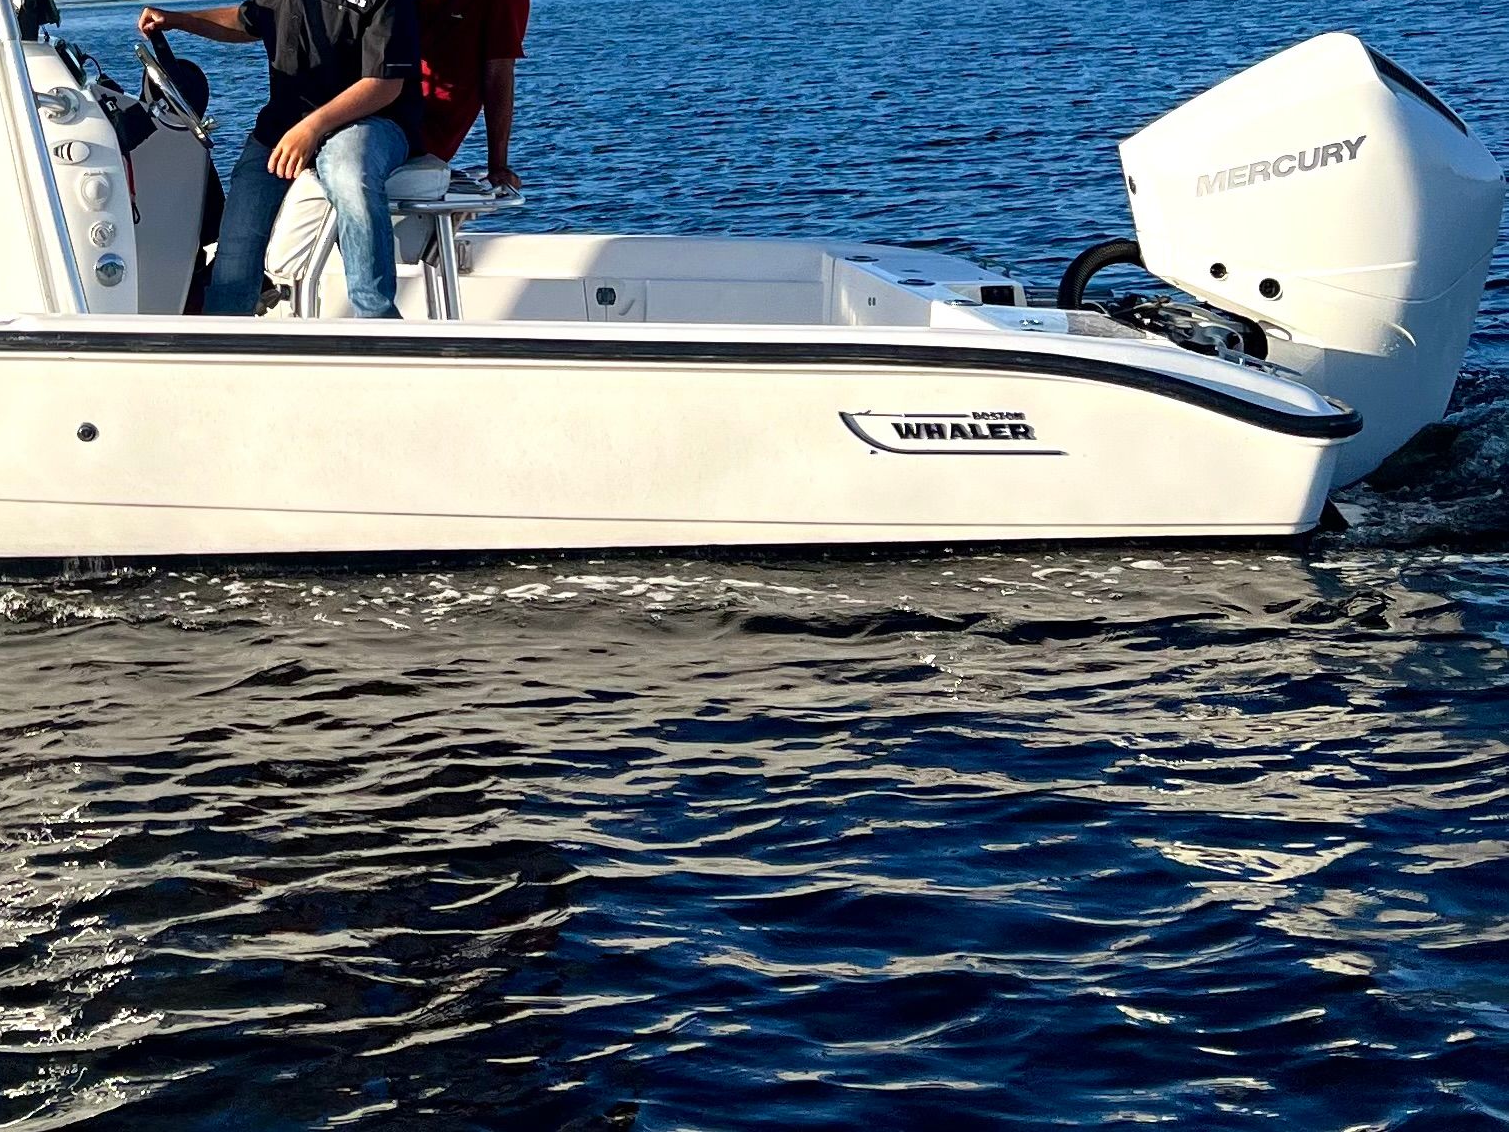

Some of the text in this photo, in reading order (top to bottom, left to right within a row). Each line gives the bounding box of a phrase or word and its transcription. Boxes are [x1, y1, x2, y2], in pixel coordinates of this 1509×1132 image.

[1195, 134, 1367, 198] MERCURY
[971, 411, 1027, 421] BOSTON
[891, 422, 1038, 441] WHALER
